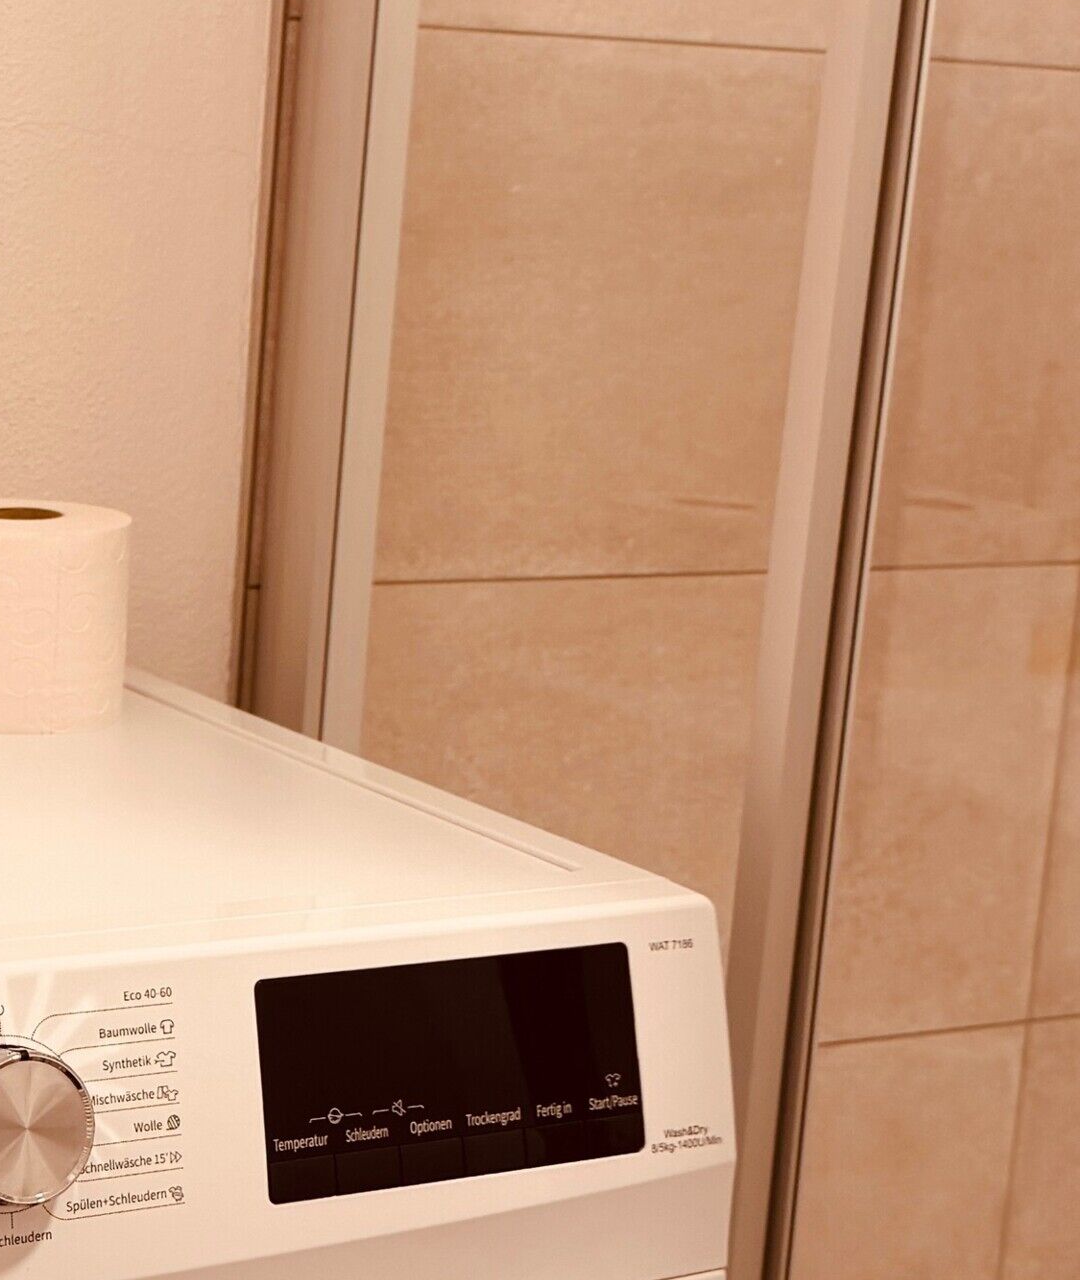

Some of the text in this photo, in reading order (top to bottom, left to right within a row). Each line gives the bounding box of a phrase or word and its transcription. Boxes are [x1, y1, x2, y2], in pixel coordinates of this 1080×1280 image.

[123, 990, 142, 1002] Eco
[99, 1023, 157, 1039] Baumwolle
[102, 1055, 152, 1072] Synthetik
[536, 1101, 573, 1119] Fertig in
[588, 1093, 639, 1111] Start/Pause
[466, 1107, 521, 1127] Trockengrad
[133, 1120, 163, 1133] Wolle
[345, 1126, 389, 1143] Schleudern
[410, 1118, 453, 1135] Optionen
[273, 1134, 328, 1153] Temperatur
[66, 1189, 167, 1214] Spülen+Schleudern
